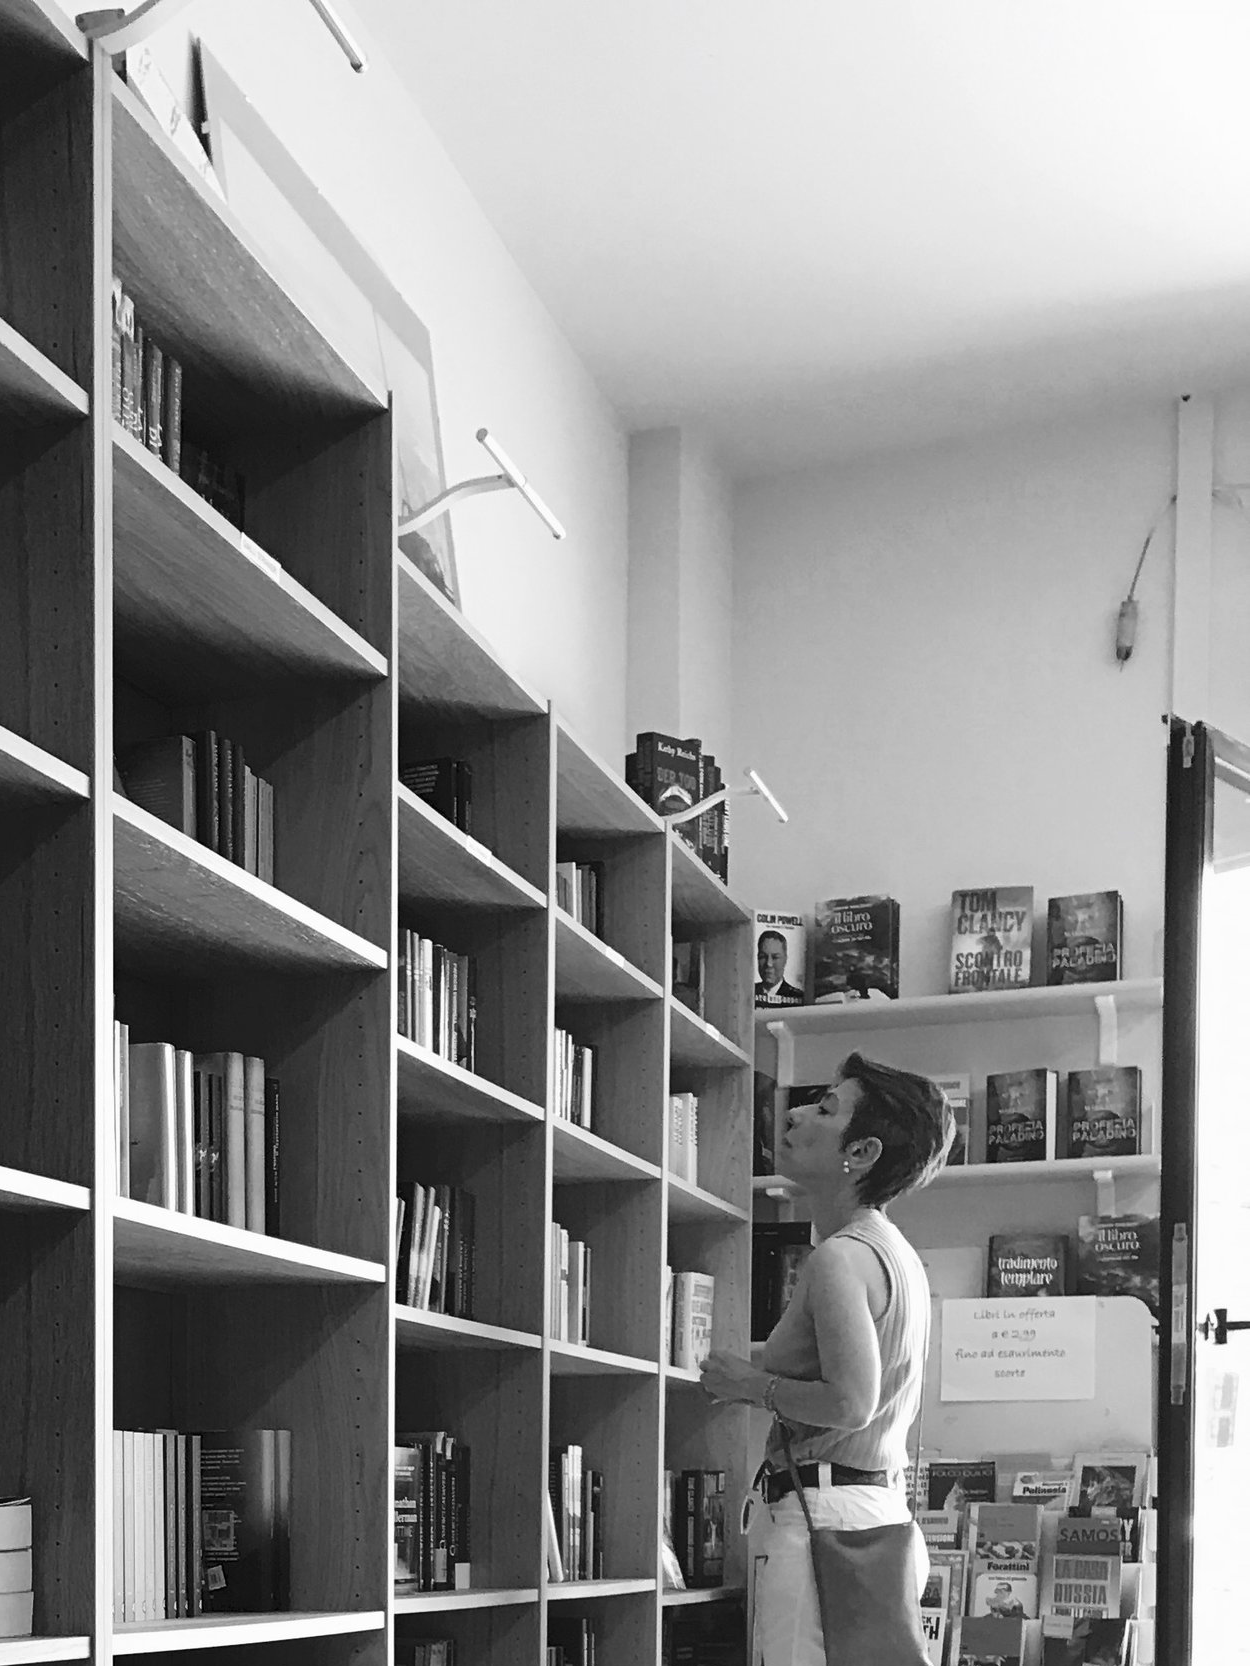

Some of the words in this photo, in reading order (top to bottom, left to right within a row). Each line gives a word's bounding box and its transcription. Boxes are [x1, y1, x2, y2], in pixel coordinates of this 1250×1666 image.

[959, 891, 997, 913] TOM
[757, 913, 776, 923] COLIN
[777, 915, 804, 926] POWELL
[834, 912, 841, 924] il
[842, 911, 871, 923] libro
[957, 911, 1027, 935] CLANCY
[831, 922, 873, 934] oscuro
[1053, 943, 1116, 958] PROFEZIA
[956, 950, 1023, 969] SCONTRO
[1052, 953, 1117, 968] PALADINO
[954, 968, 1024, 987] FRONTALE
[989, 1120, 1044, 1135] PROFEZIA
[1073, 1118, 1136, 1133] PROFEZIA
[989, 1130, 1045, 1145] PALADINO
[1072, 1128, 1136, 1141] PALADINO
[1097, 1230, 1106, 1241] il
[1107, 1229, 1138, 1241] libro
[1095, 1242, 1140, 1252] oscuro
[998, 1256, 1058, 1270] tradimento
[1001, 1271, 1053, 1287] templare
[1003, 1310, 1015, 1319] in
[1018, 1308, 1055, 1322] offerta
[954, 1348, 978, 1361] fino
[981, 1349, 995, 1358] ad
[997, 1349, 1066, 1358] esaurimento
[994, 1369, 1025, 1378] scorte
[1060, 1528, 1119, 1542] SAMOS
[987, 1561, 1029, 1571] Forattini
[1055, 1559, 1069, 1579] LA
[1074, 1560, 1108, 1580] CASA
[1054, 1583, 1107, 1605] RUSSIA
